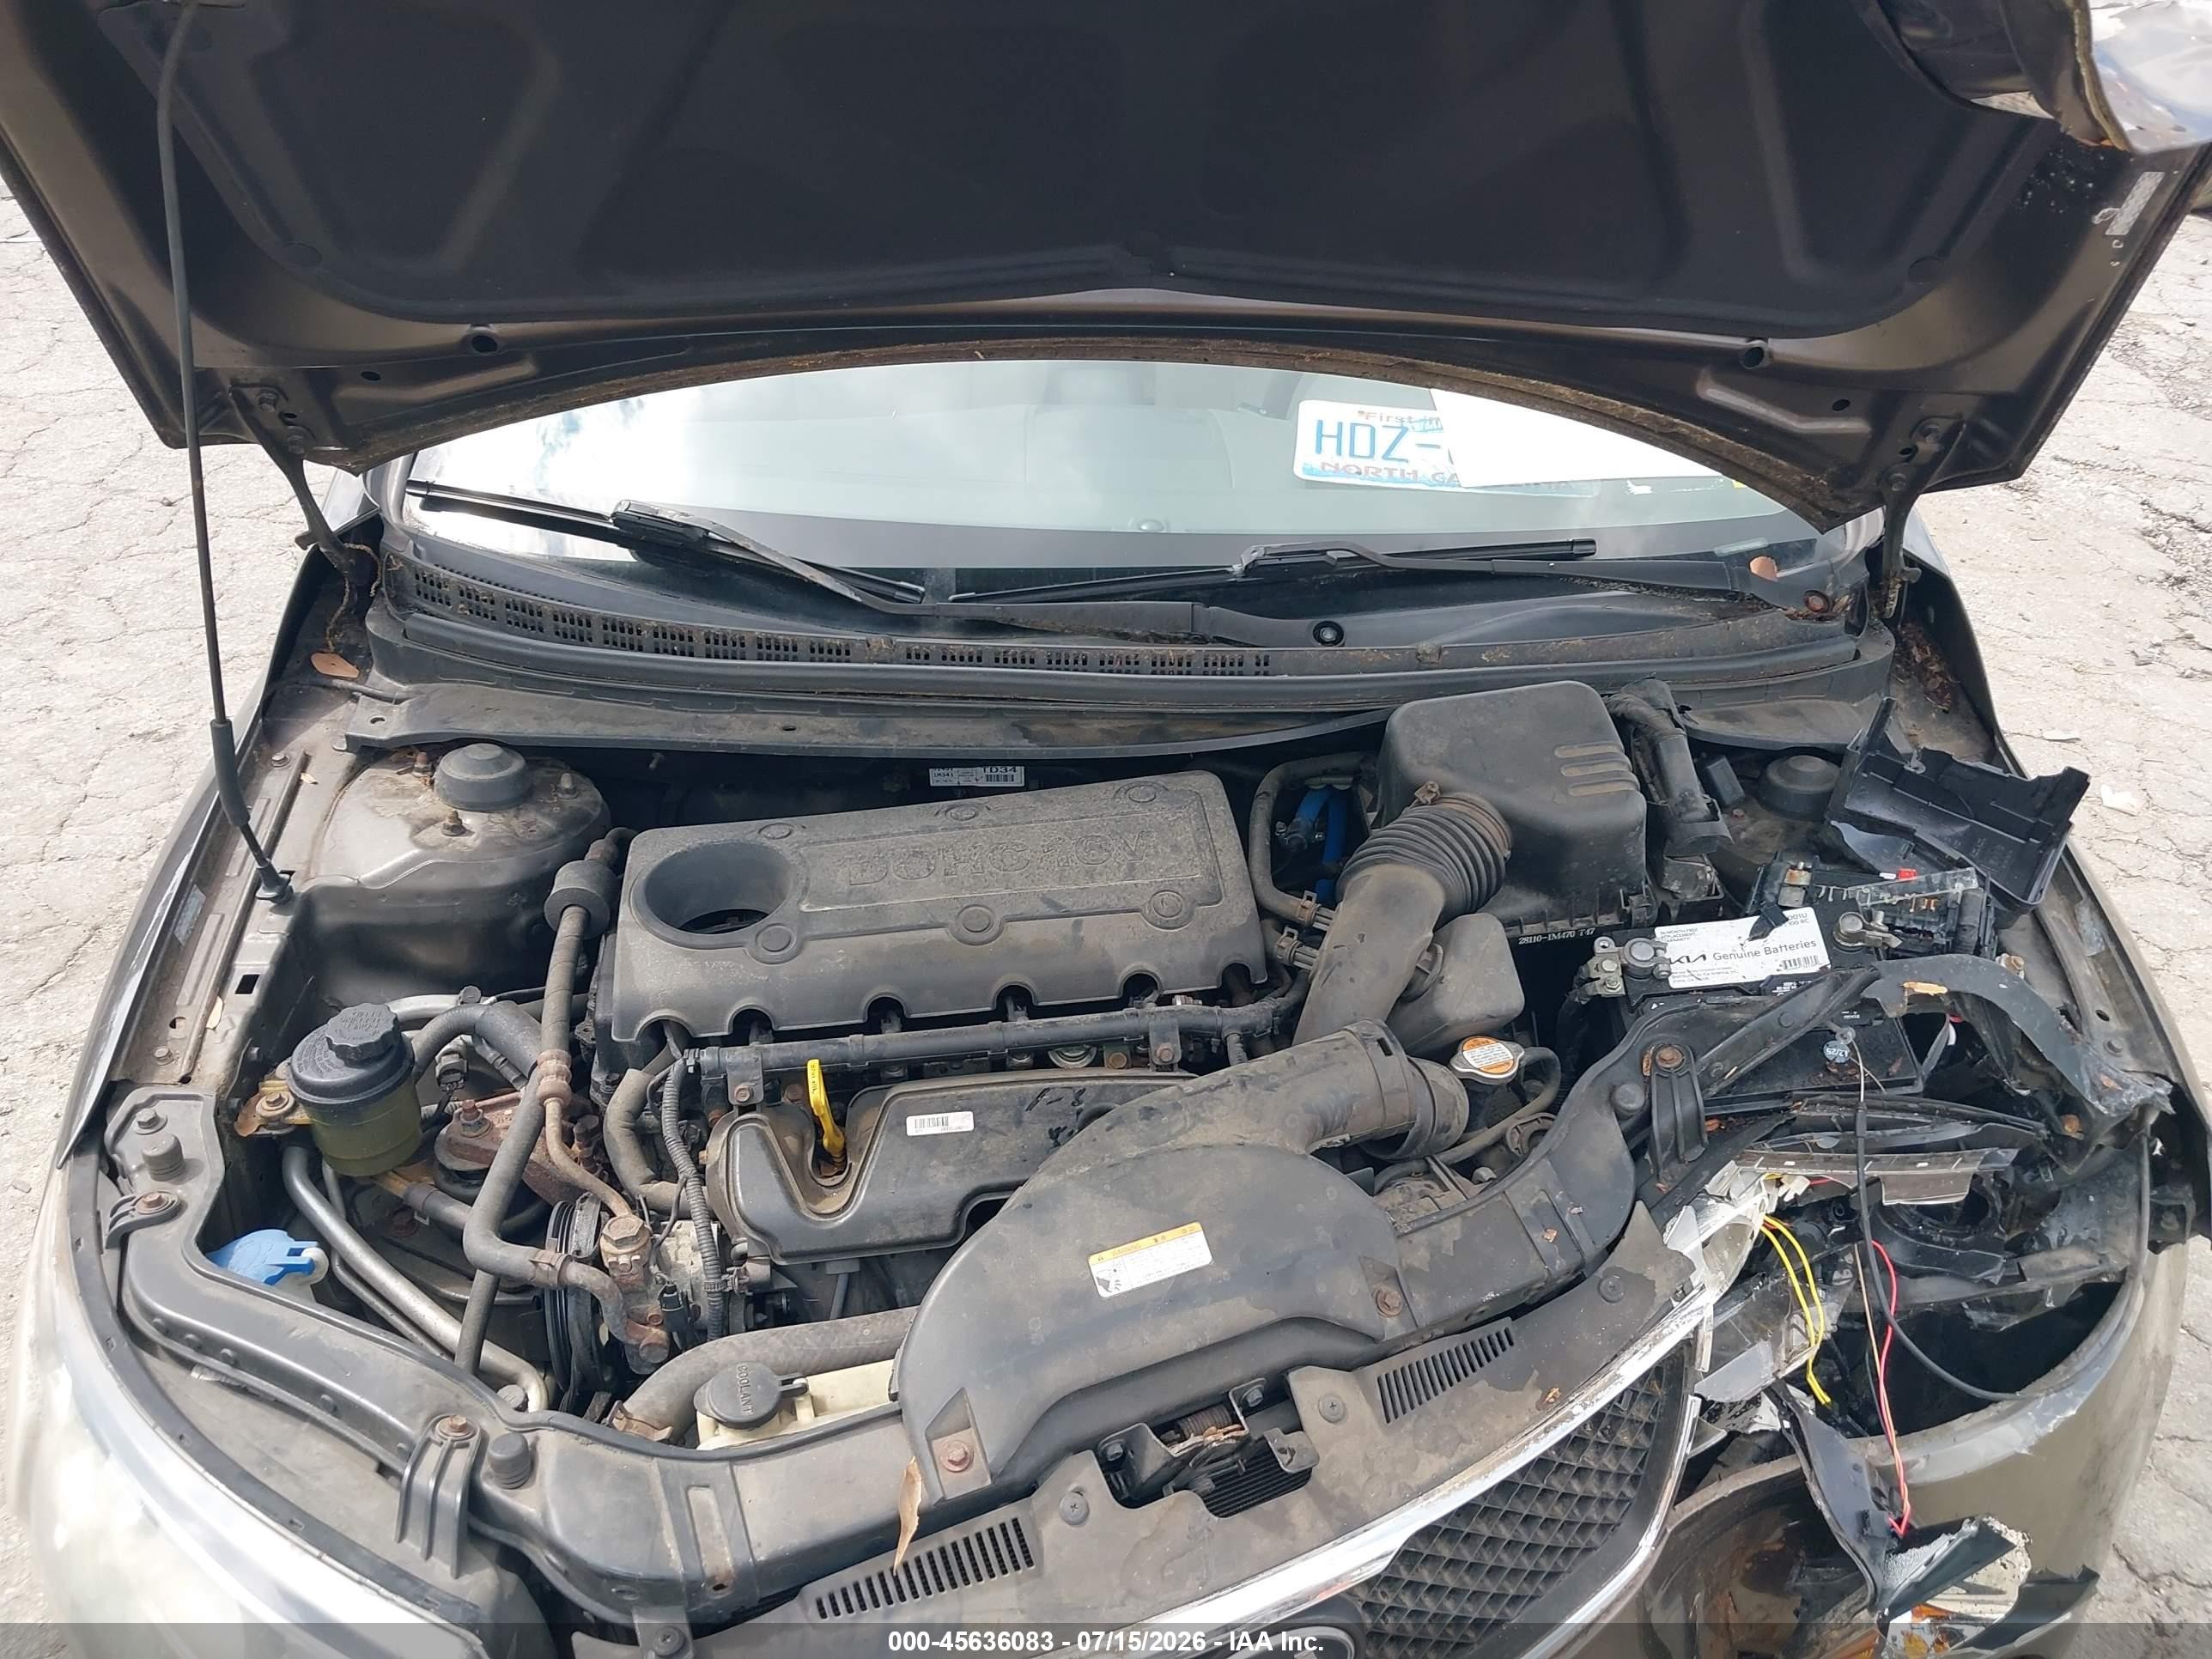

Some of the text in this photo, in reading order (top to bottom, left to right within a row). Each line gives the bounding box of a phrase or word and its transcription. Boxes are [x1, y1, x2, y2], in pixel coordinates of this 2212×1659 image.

[1316, 419, 1454, 465] HDZ-
[1712, 950, 1761, 961] Genuine
[1764, 939, 1817, 956] Batteries
[737, 1364, 754, 1416] COOLANT
